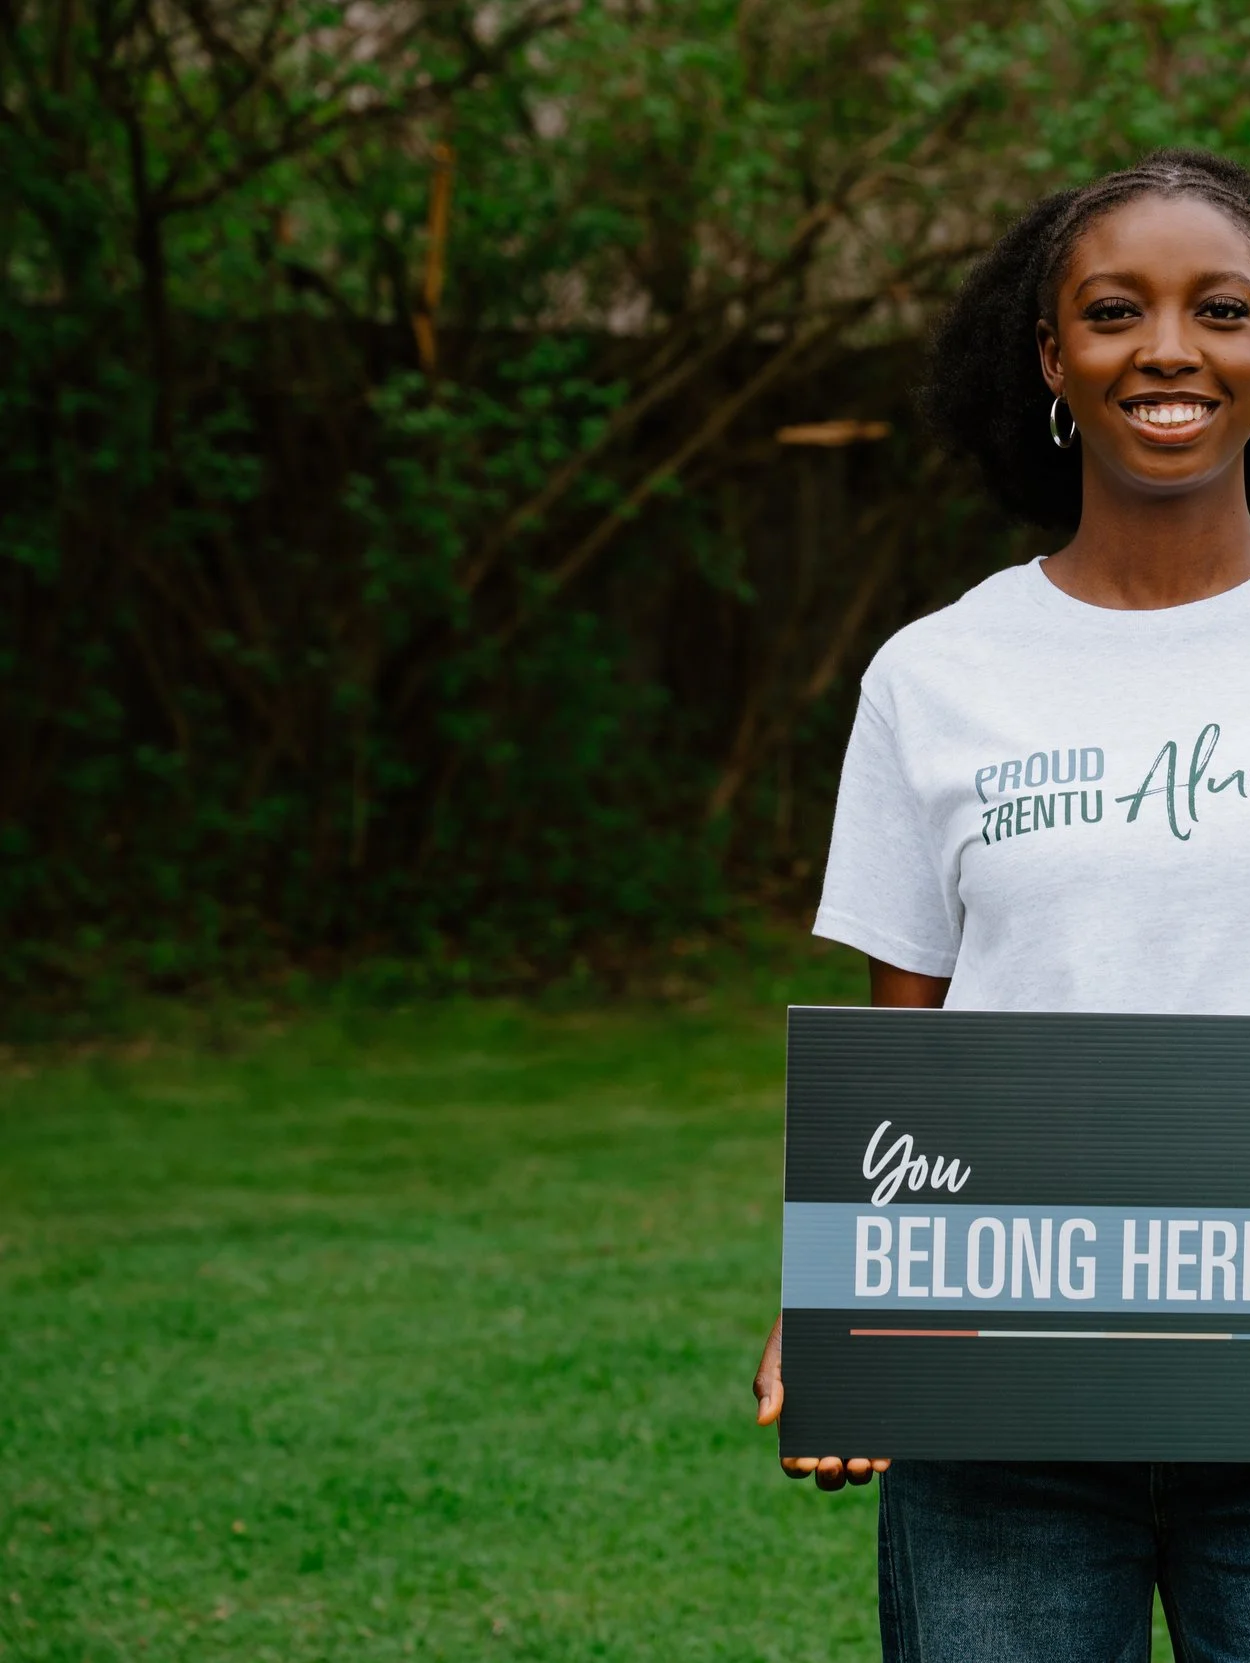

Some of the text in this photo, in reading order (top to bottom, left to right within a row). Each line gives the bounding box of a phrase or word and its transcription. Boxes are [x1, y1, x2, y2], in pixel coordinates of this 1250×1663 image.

[974, 746, 1105, 804] PROUD
[981, 789, 1104, 846] TRENTU
[862, 1120, 972, 1208] You
[854, 1215, 1097, 1299] BELONG
